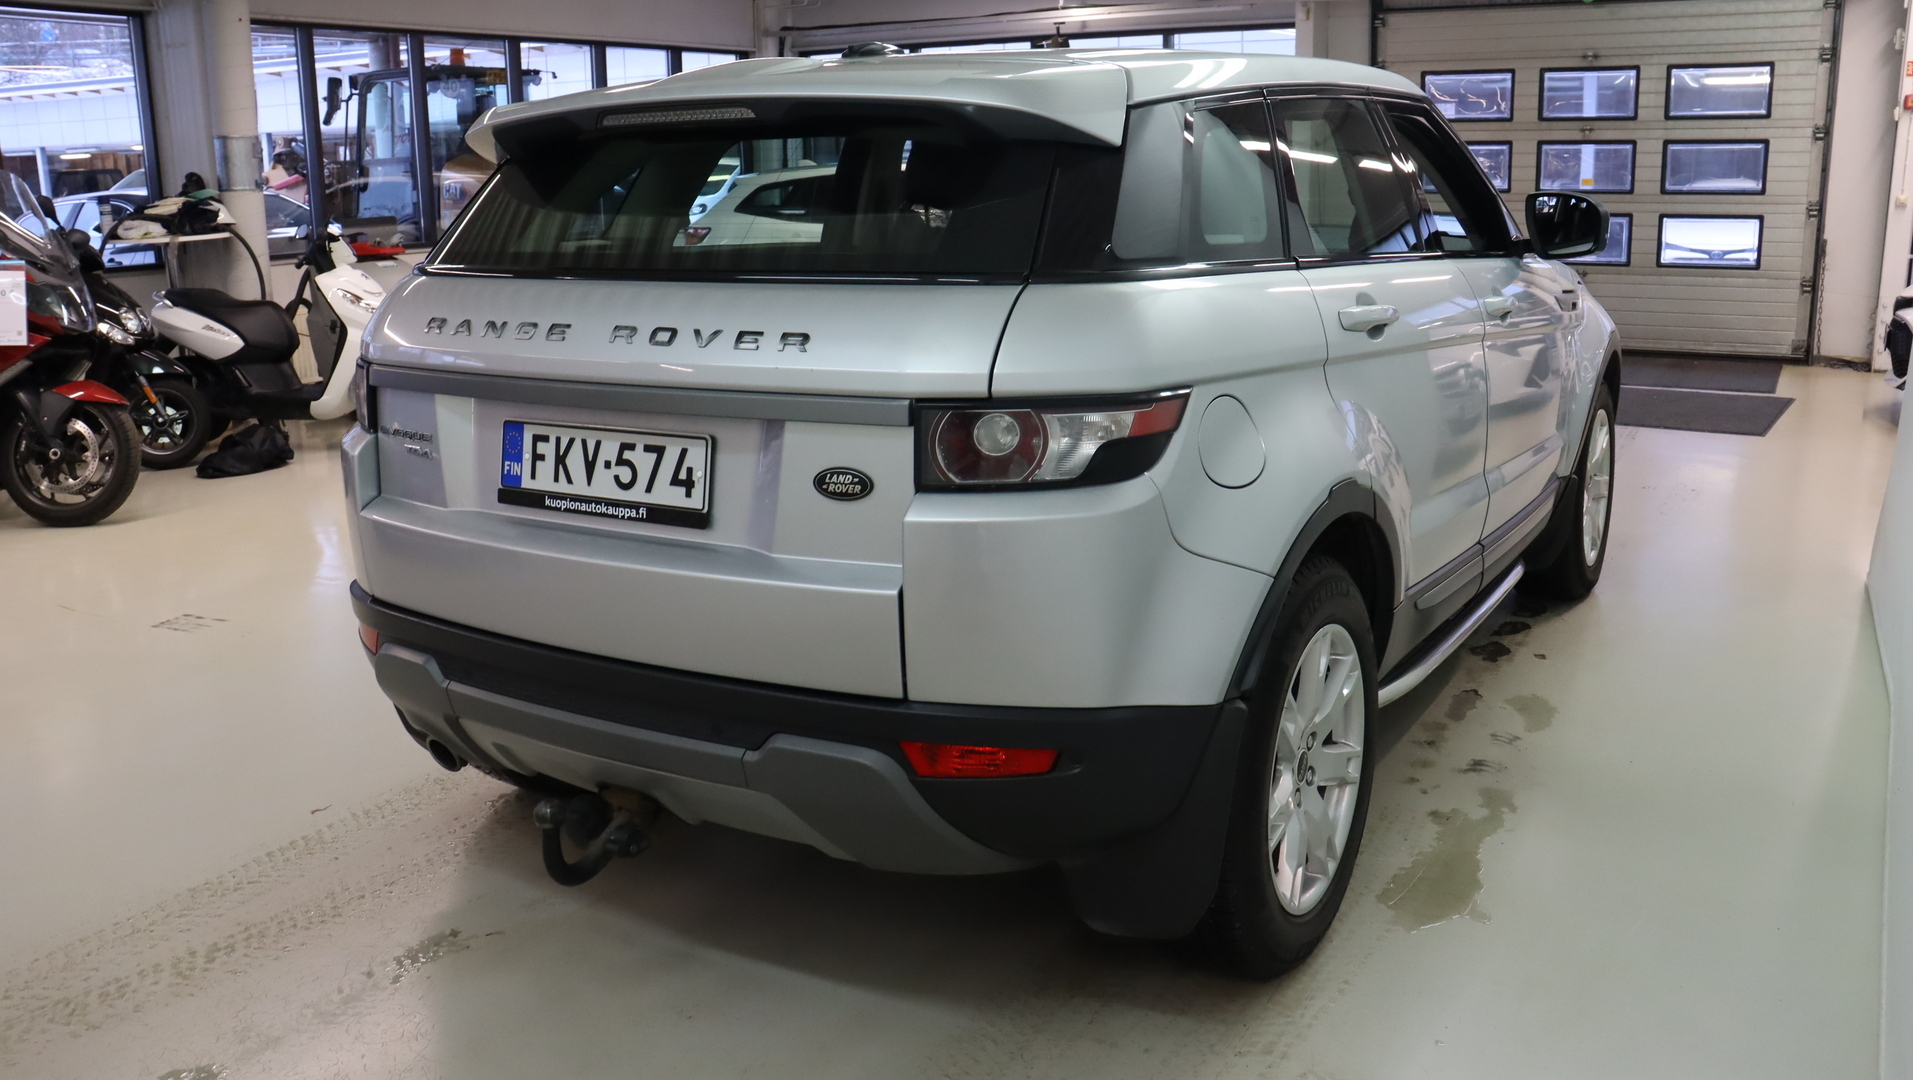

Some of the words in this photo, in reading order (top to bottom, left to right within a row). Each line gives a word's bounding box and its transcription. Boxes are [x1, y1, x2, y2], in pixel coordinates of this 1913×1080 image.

[423, 316, 572, 342] RANGE
[608, 324, 812, 353] ROVER
[504, 461, 521, 476] FIN
[530, 433, 696, 498] FKV-574
[828, 483, 861, 494] ROVER
[545, 495, 647, 519] kuopionautokauppa.fi
